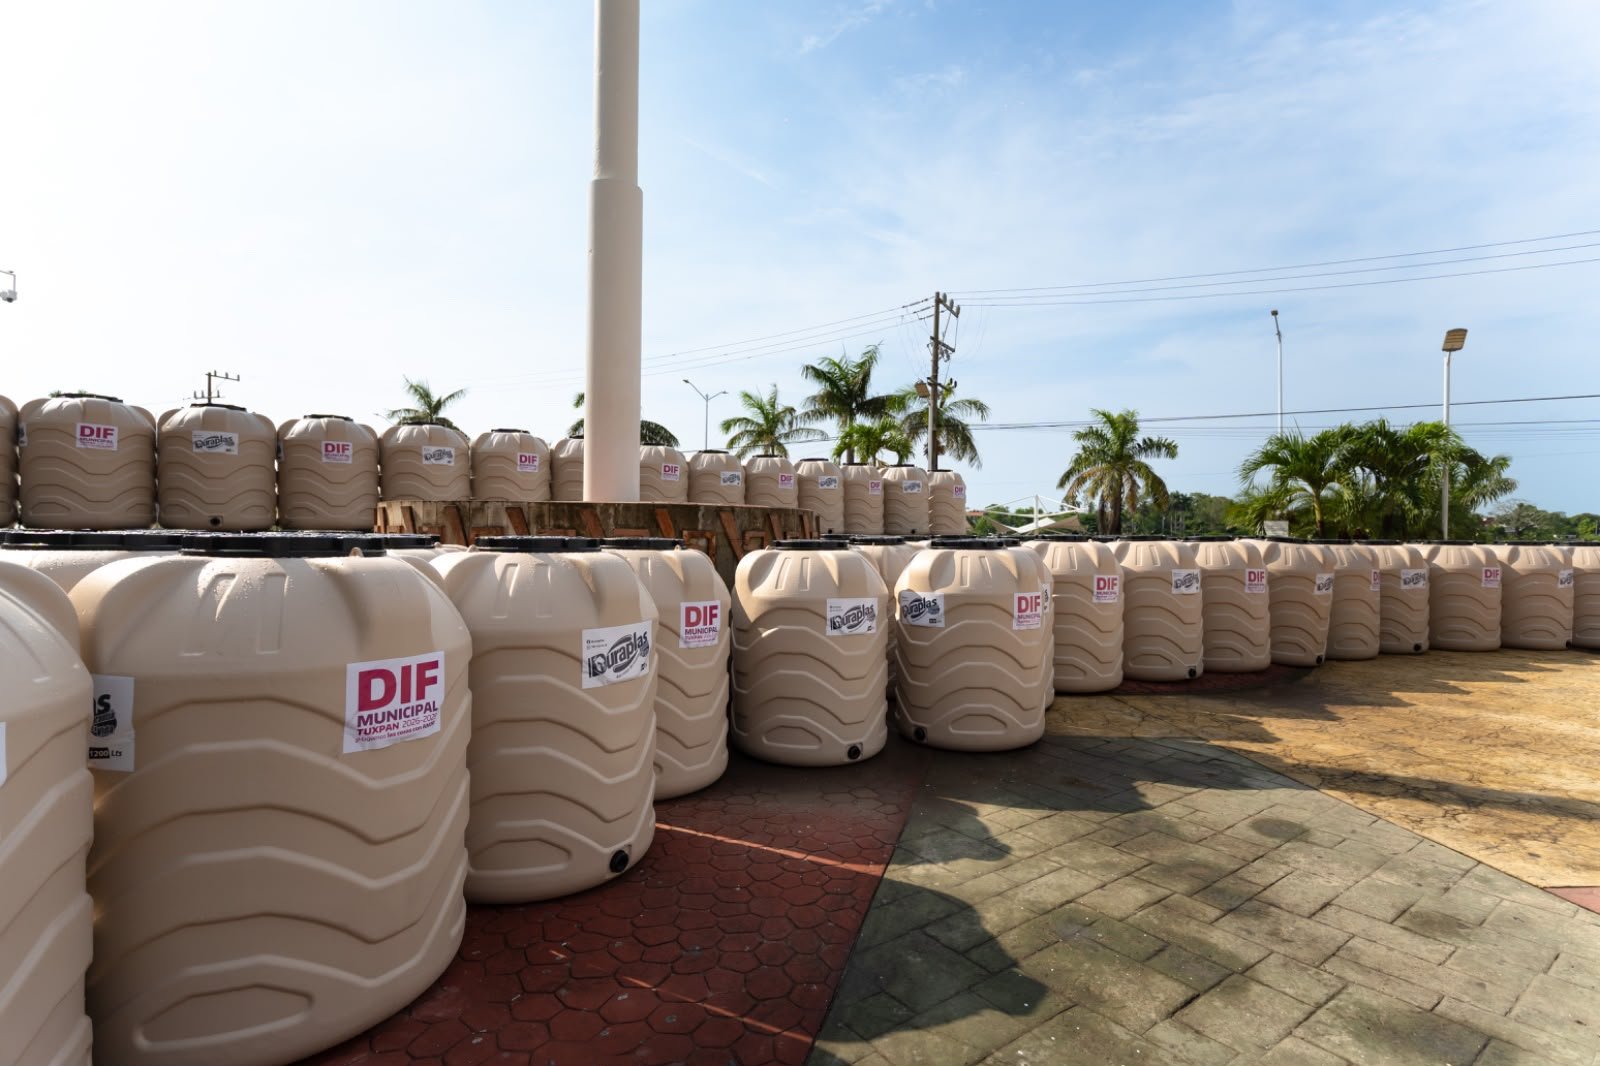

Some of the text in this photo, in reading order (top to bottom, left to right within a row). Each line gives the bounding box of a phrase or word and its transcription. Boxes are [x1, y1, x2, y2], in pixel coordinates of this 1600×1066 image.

[80, 425, 114, 439] DIF
[324, 443, 350, 453] DIF
[519, 454, 537, 464] DIF
[663, 465, 679, 473] DIF
[1248, 571, 1264, 582] DIF
[1484, 569, 1500, 578] DIF
[1096, 577, 1117, 590] DIF
[1017, 595, 1040, 613] DIF
[685, 605, 718, 627] DIF
[830, 604, 874, 630] Duraplas
[588, 631, 648, 678] Duraplas
[358, 660, 439, 712] DIF
[357, 701, 438, 727] MUNICIPAL
[357, 722, 400, 736] TUXPAN
